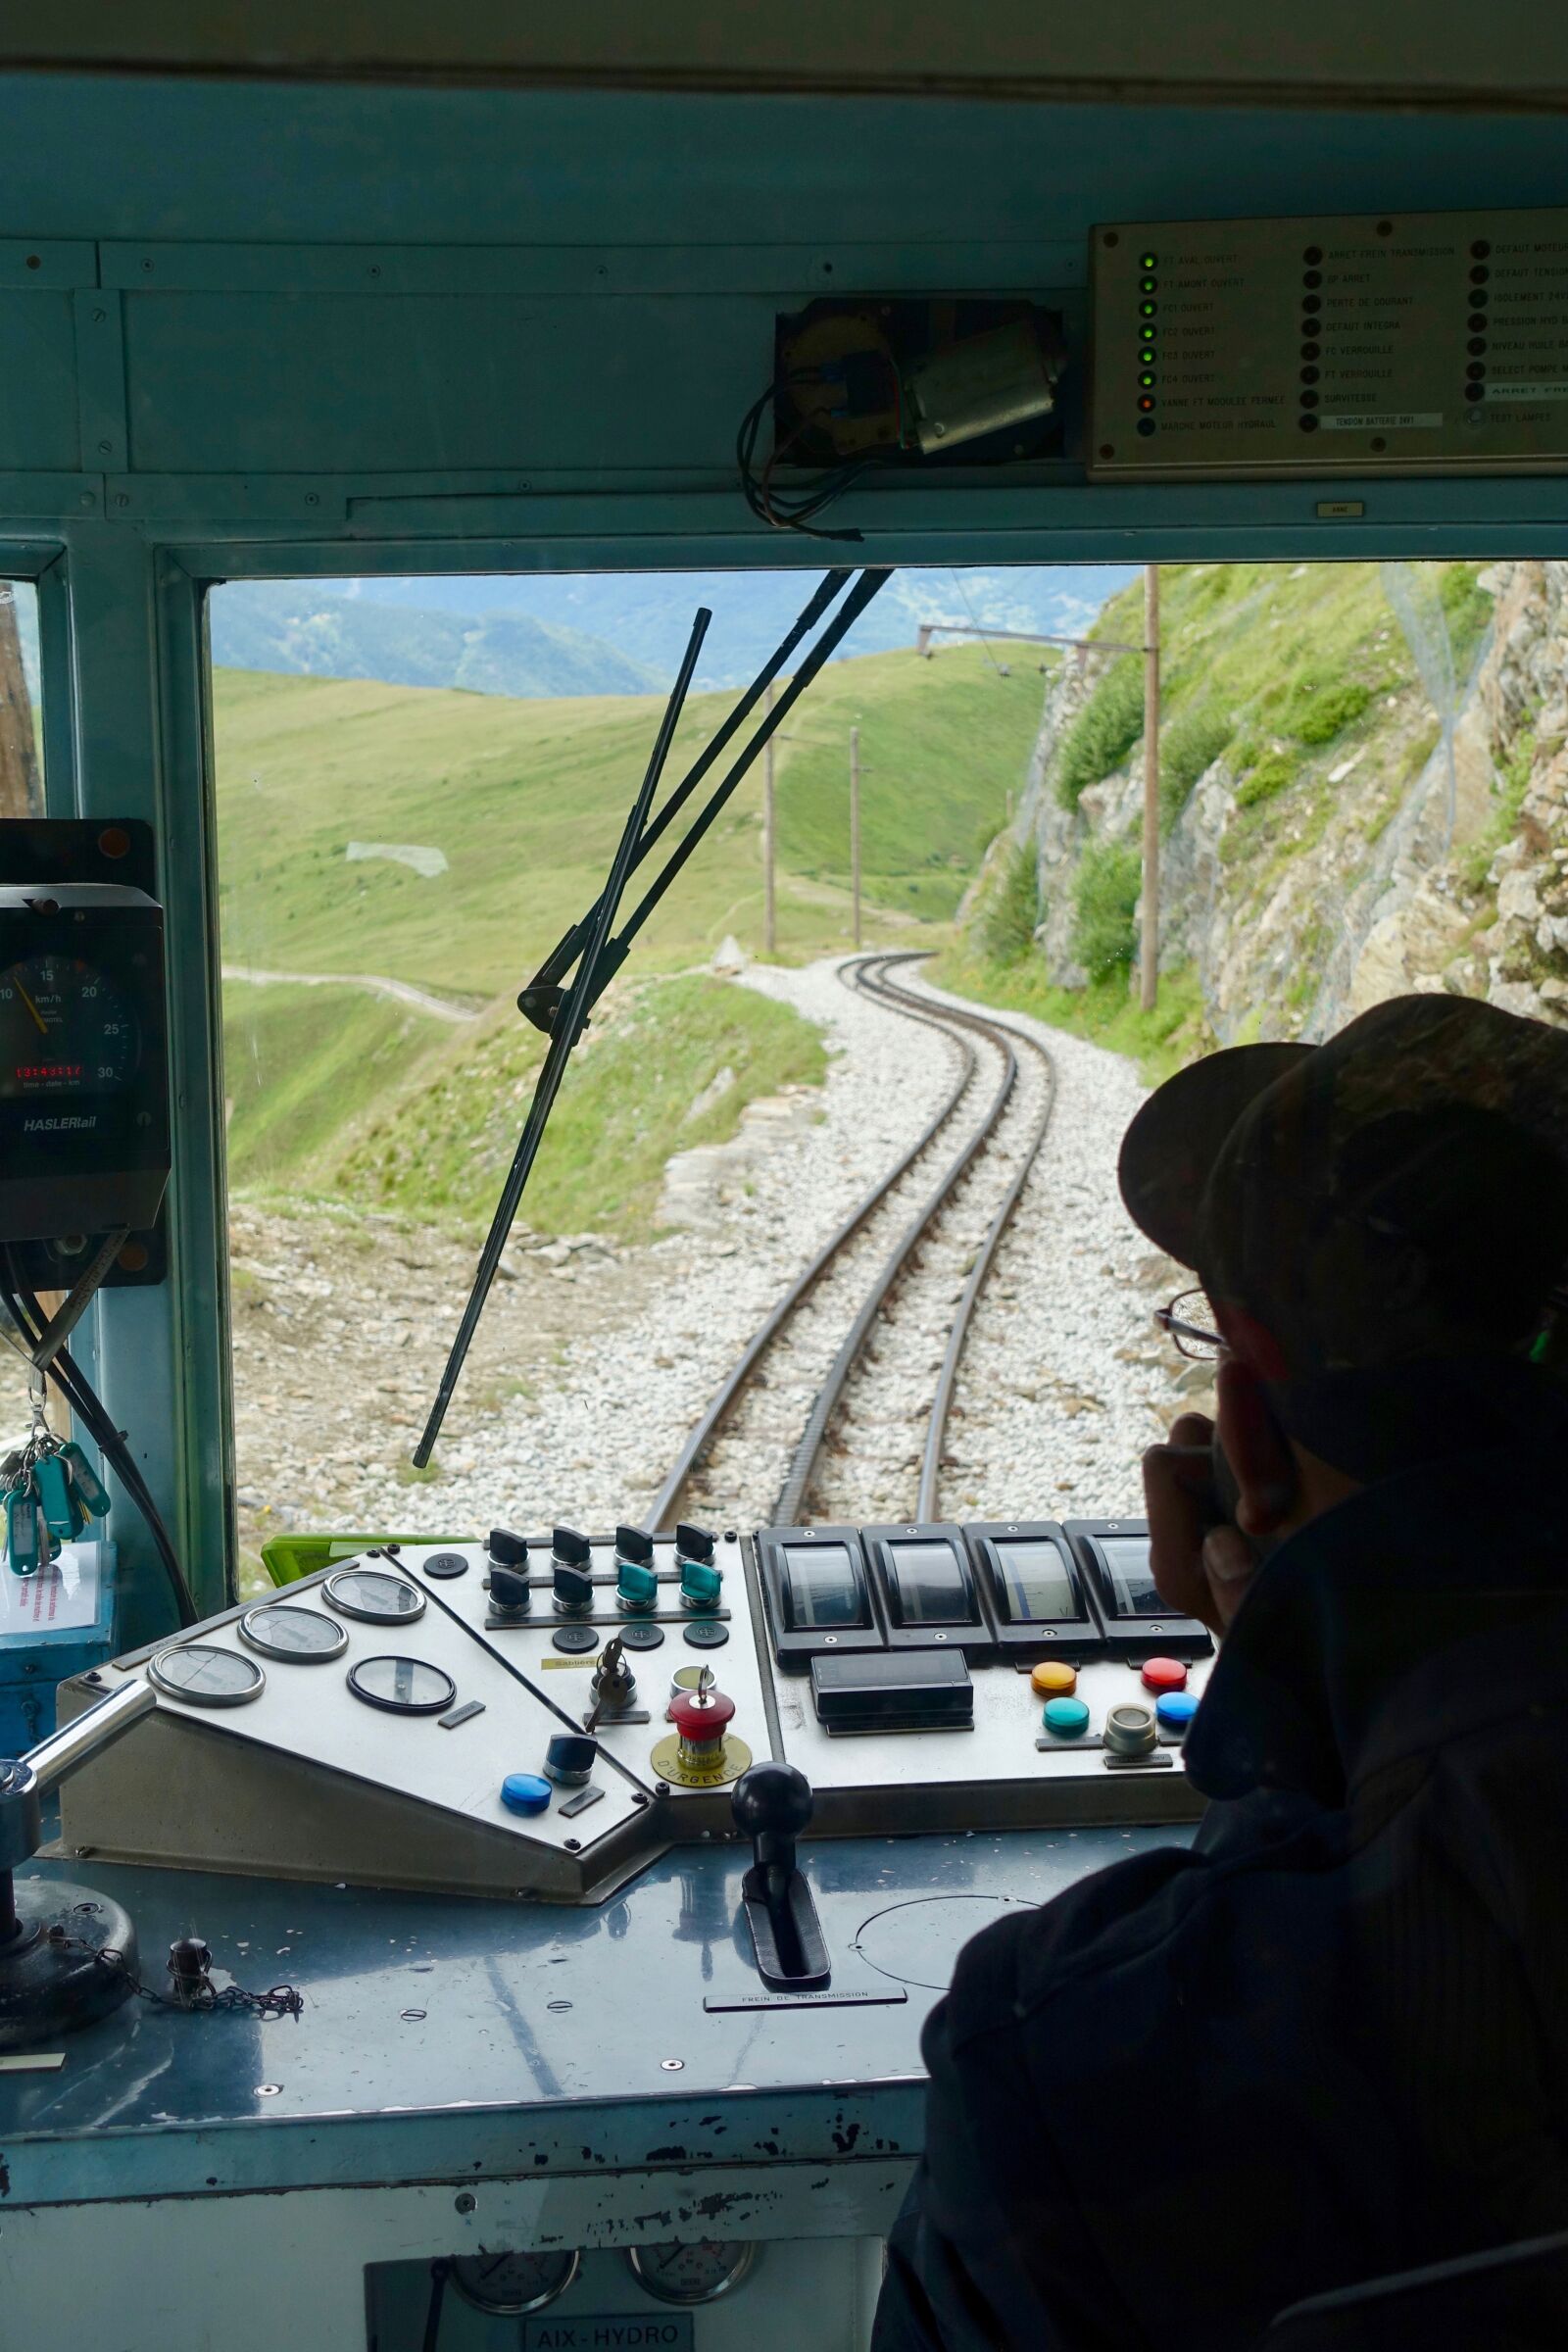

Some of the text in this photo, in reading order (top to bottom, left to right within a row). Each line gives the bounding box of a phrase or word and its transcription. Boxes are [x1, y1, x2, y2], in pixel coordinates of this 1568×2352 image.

[1360, 250, 1386, 259] FREIN
[1391, 248, 1454, 257] TRANSMISSION
[1494, 269, 1529, 277] DEFAUT
[1211, 278, 1245, 287] OUVERT
[1374, 297, 1413, 306] COURANT
[1326, 322, 1358, 331] DEFAUT
[1494, 318, 1536, 326] PRESSION
[1341, 345, 1394, 354] VERROUILLE
[1493, 342, 1525, 351] NIVEAU
[1341, 369, 1393, 378] VERROUILLE
[1529, 365, 1557, 373] POMPE
[40, 970, 54, 981] 15
[0, 989, 13, 999] 10
[82, 987, 96, 998] 20
[35, 995, 61, 1004] km/h
[104, 1024, 119, 1035] 25
[98, 1067, 113, 1078] 30
[658, 1760, 743, 1784] D'URGENCE
[797, 1990, 868, 2000] TRANSMISSION
